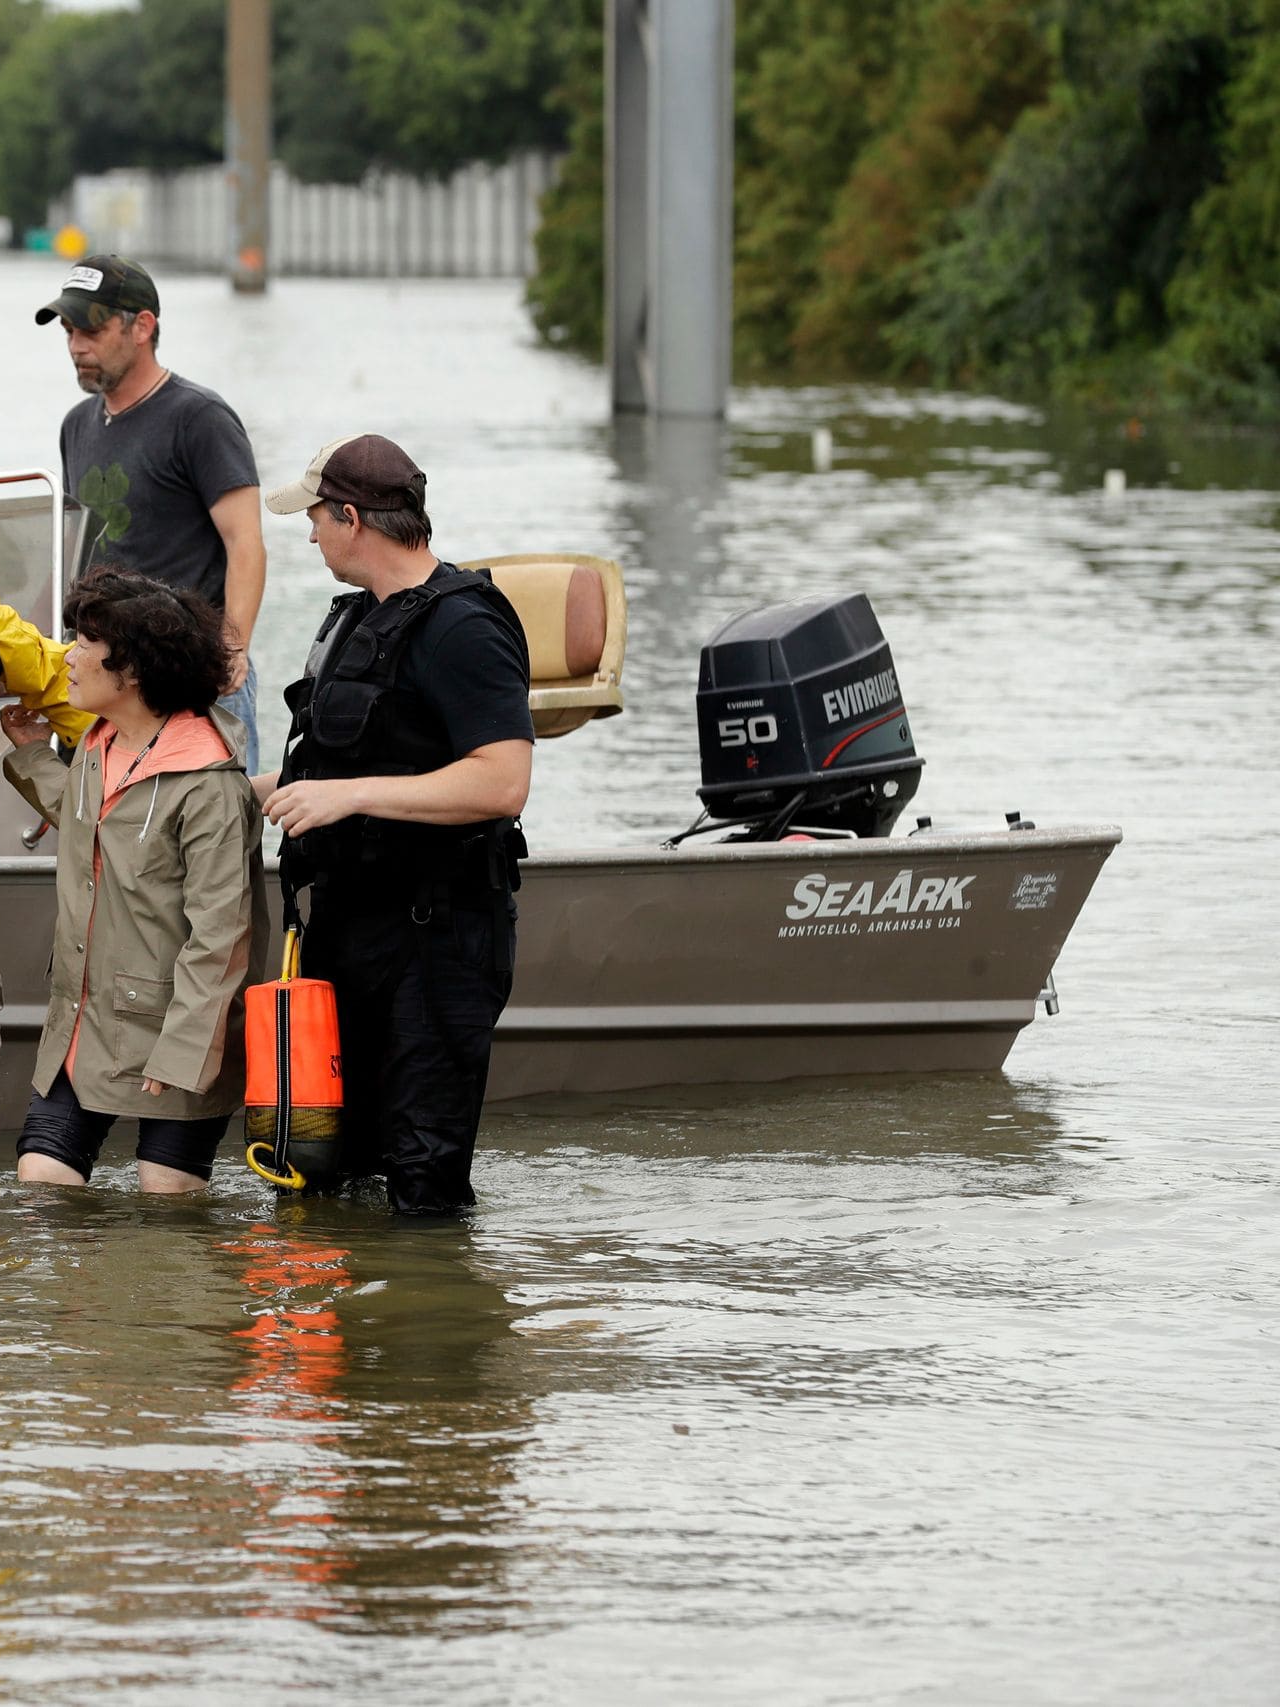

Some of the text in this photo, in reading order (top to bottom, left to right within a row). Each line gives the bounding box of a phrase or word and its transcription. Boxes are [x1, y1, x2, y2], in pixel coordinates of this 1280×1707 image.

[822, 668, 898, 724] EVINRUDE
[718, 714, 778, 748] 50
[778, 916, 962, 939] MONTICELLO, ARKANSAS USA
